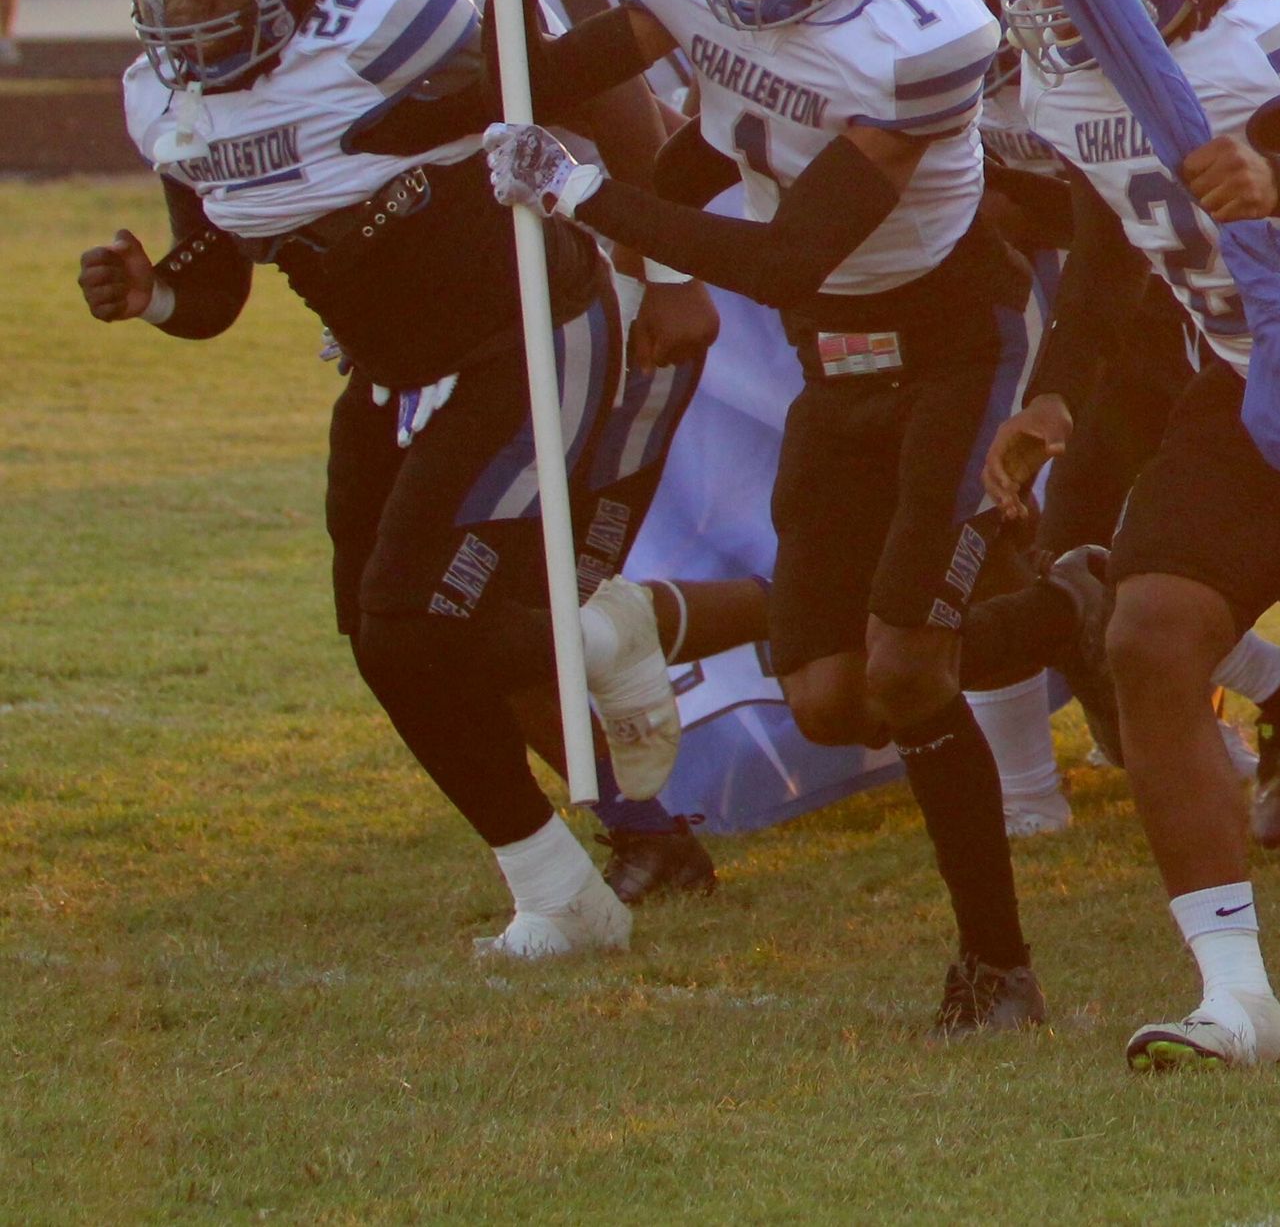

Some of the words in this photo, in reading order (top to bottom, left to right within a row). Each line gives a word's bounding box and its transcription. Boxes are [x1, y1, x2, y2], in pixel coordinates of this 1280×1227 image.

[691, 33, 829, 129] CHARLESTON
[441, 532, 499, 610] JAYS
[945, 523, 986, 605] JAYS
